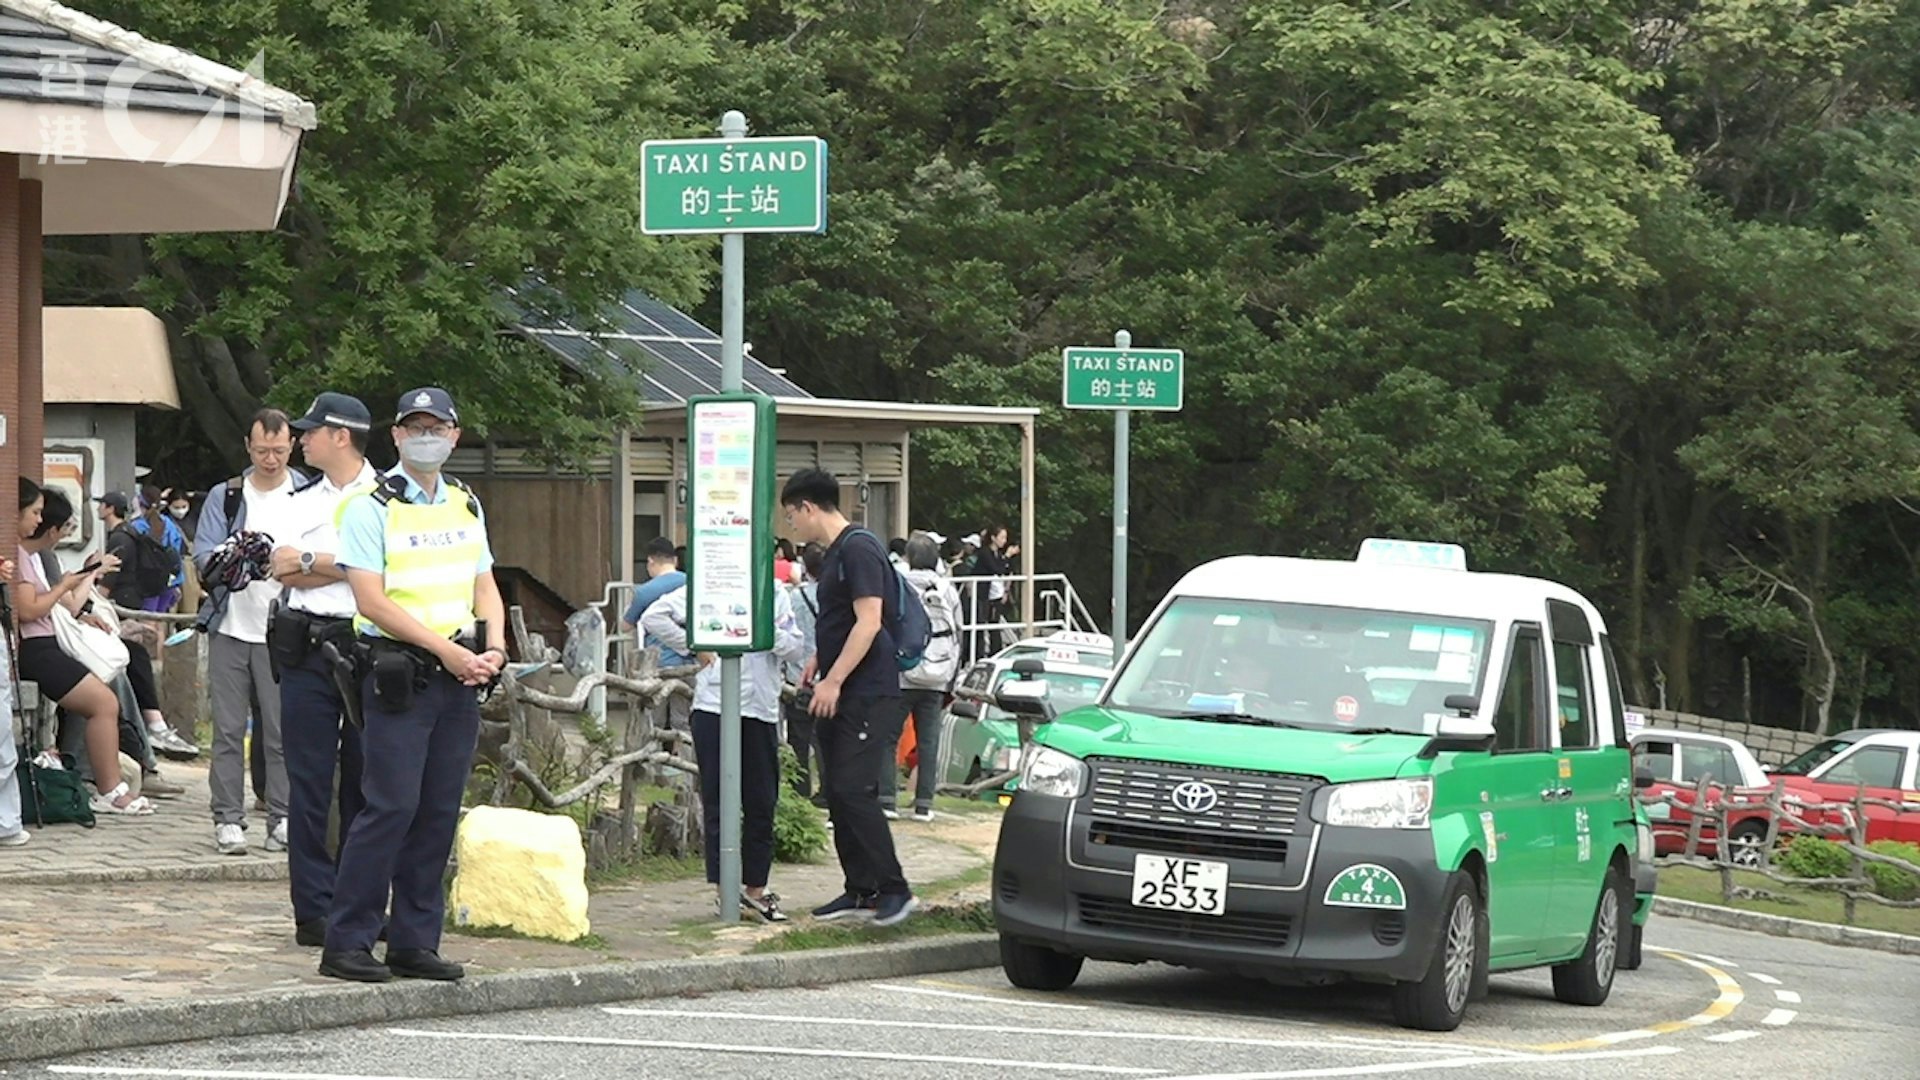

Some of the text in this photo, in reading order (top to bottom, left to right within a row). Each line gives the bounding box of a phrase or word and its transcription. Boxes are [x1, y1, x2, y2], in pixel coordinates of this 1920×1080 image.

[653, 151, 807, 175] TAXI STAND
[681, 184, 780, 215] 的士站
[1072, 356, 1175, 373] TAXI STAND
[1091, 378, 1156, 399] 的士站
[1369, 541, 1454, 564] TAXI
[1061, 633, 1100, 644] TAXI
[1051, 650, 1077, 660] TAXI
[1336, 701, 1356, 715] TAXI
[1162, 859, 1202, 884] XF
[1347, 868, 1390, 883] TAXI
[1361, 877, 1375, 895] 4
[1139, 881, 1218, 911] 2533
[1341, 892, 1393, 904] SEATS
